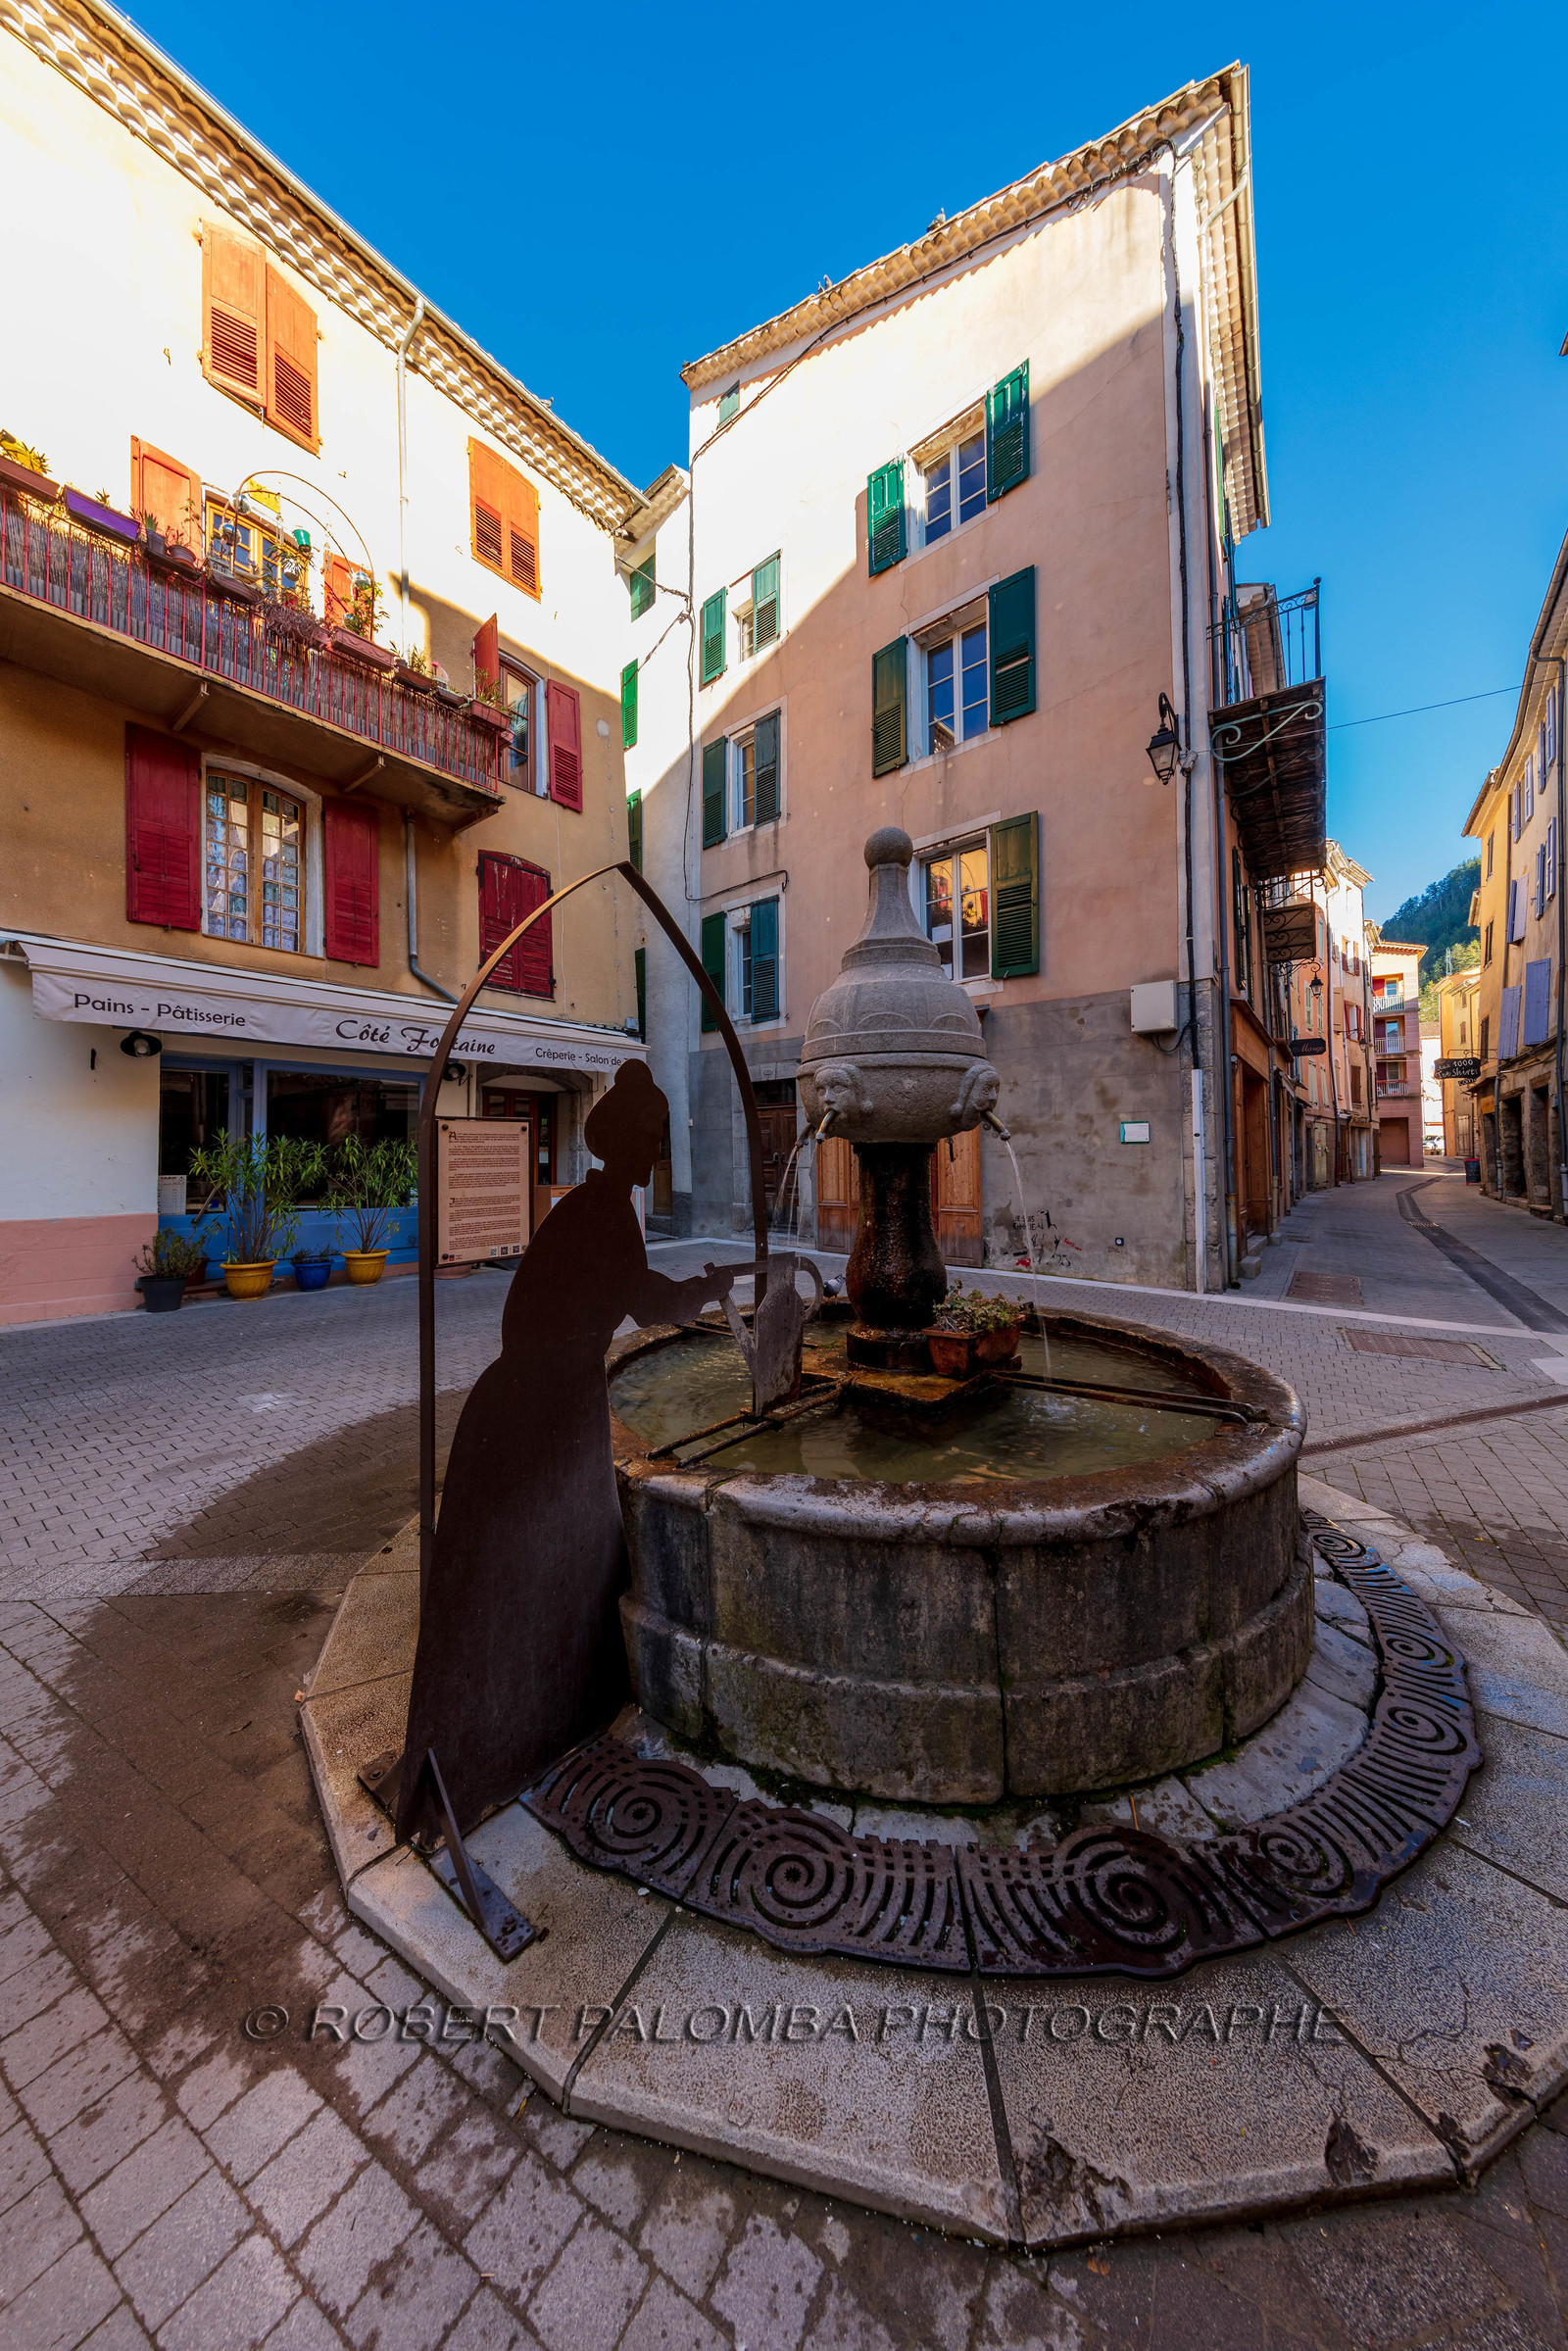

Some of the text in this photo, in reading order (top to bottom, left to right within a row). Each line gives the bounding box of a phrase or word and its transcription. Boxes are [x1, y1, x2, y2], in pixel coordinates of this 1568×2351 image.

[74, 993, 134, 1014] Pains
[157, 1003, 246, 1027] Pâtisserie
[335, 1019, 496, 1054] Côté Fotaine
[535, 1047, 576, 1061] Crêperie
[585, 1053, 609, 1065] Salon
[612, 1057, 621, 1066] de
[1436, 1067, 1479, 1079] Tee Shirts
